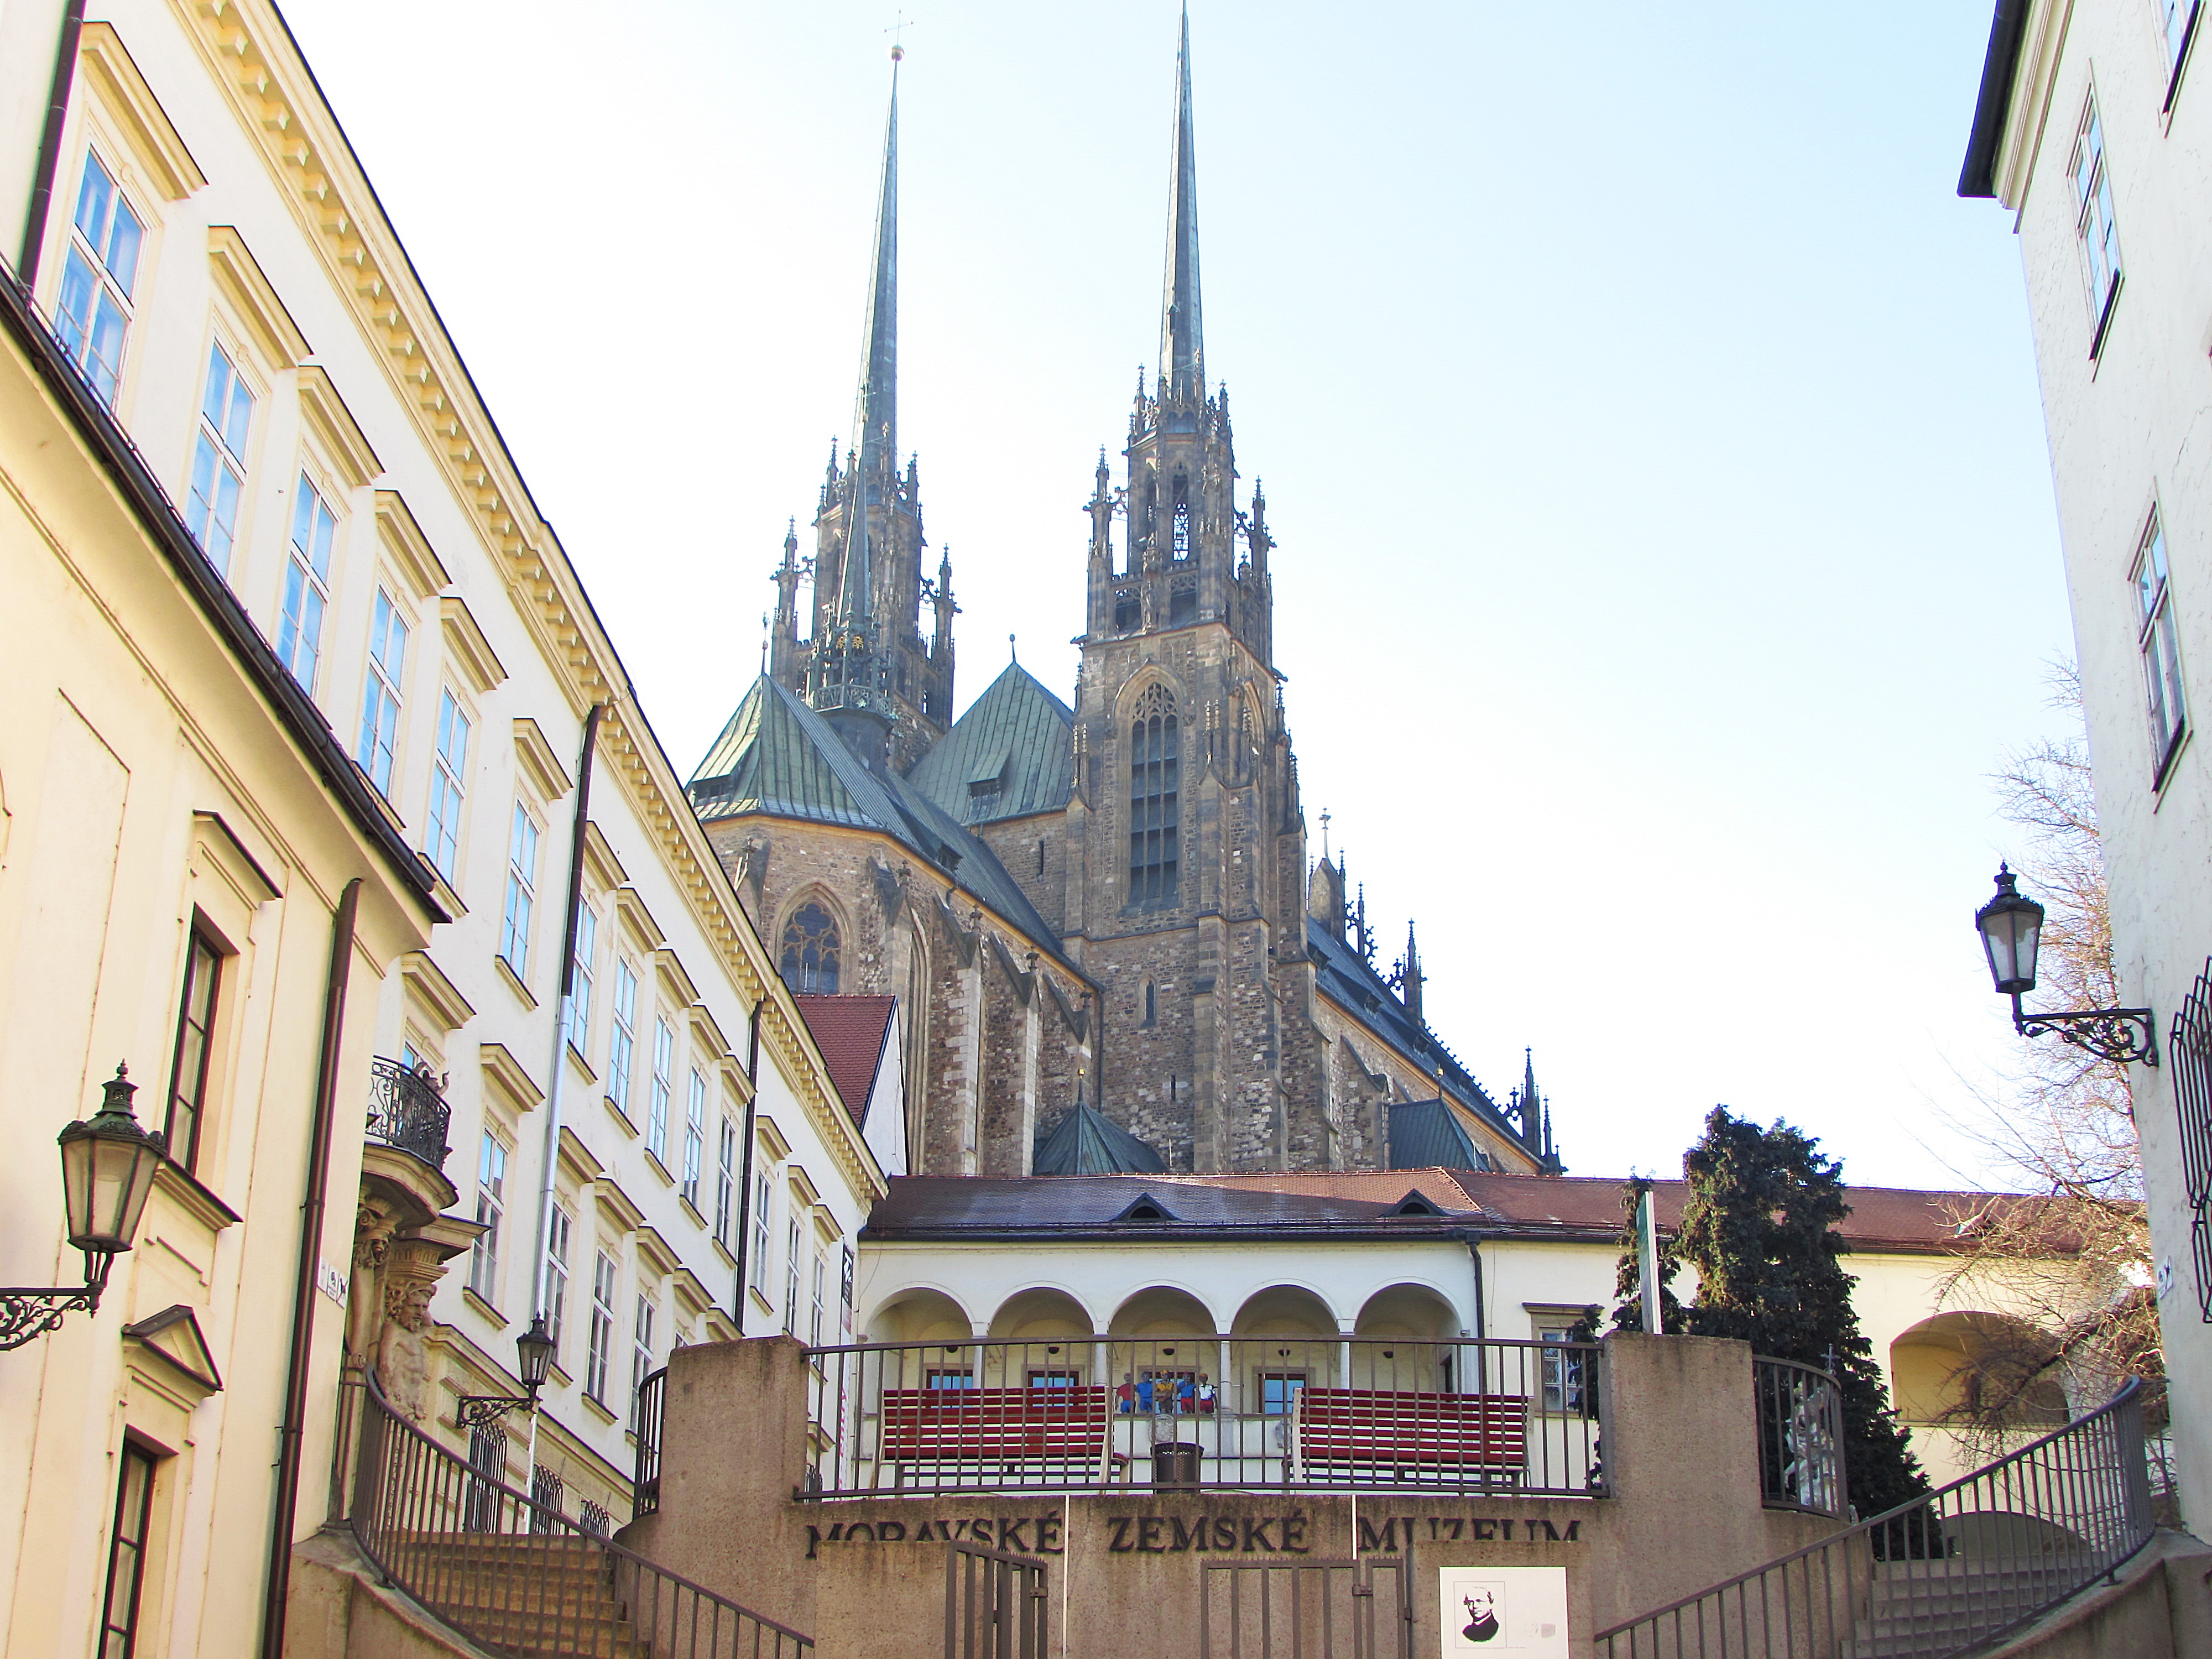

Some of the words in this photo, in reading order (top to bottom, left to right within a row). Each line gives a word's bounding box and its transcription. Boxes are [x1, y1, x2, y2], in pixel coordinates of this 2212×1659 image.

[805, 1510, 1065, 1560] MORAVSKÉ
[1107, 1508, 1310, 1553] ZEMSKÉ
[1358, 1516, 1581, 1552] MUZEUM
